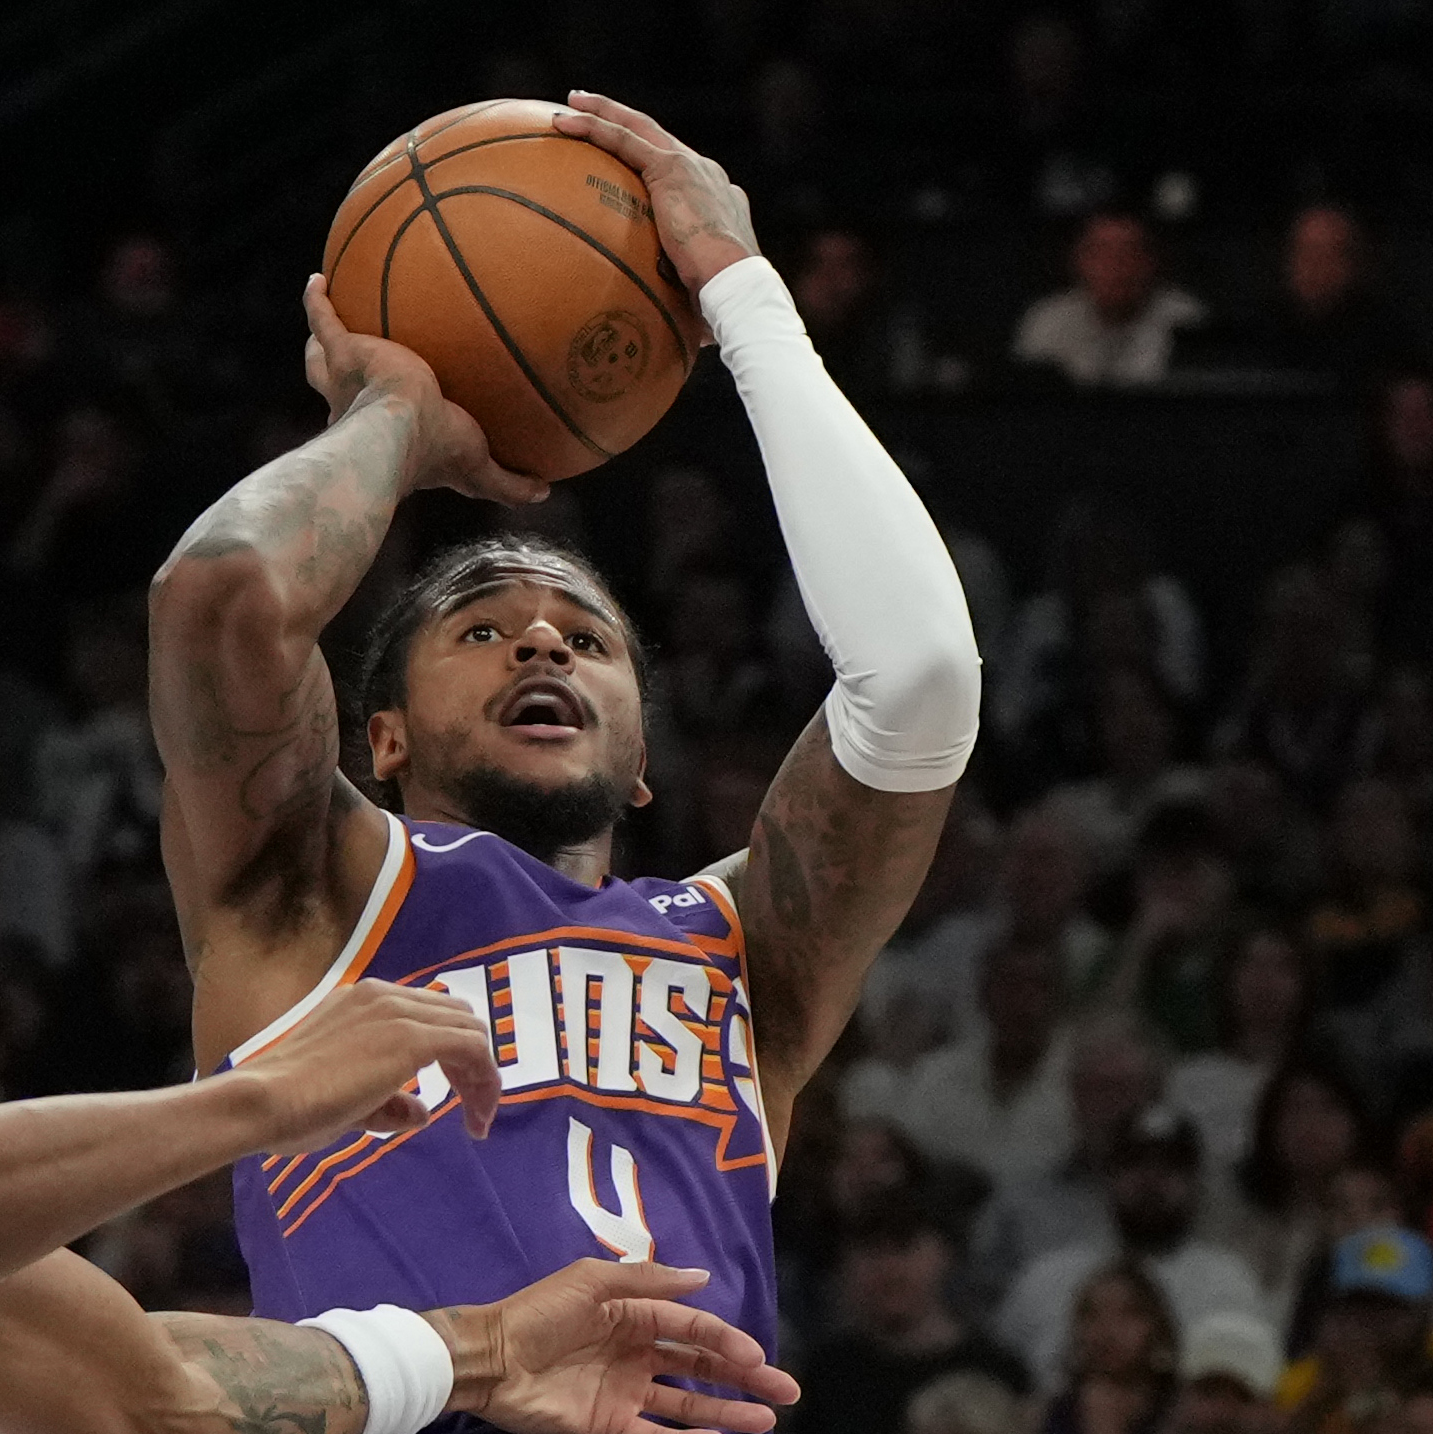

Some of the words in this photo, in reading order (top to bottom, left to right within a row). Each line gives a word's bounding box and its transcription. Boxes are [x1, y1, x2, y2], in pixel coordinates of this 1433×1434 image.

[648, 886, 706, 914] Pal
[366, 945, 710, 1140] UNS
[567, 1116, 656, 1264] 4
